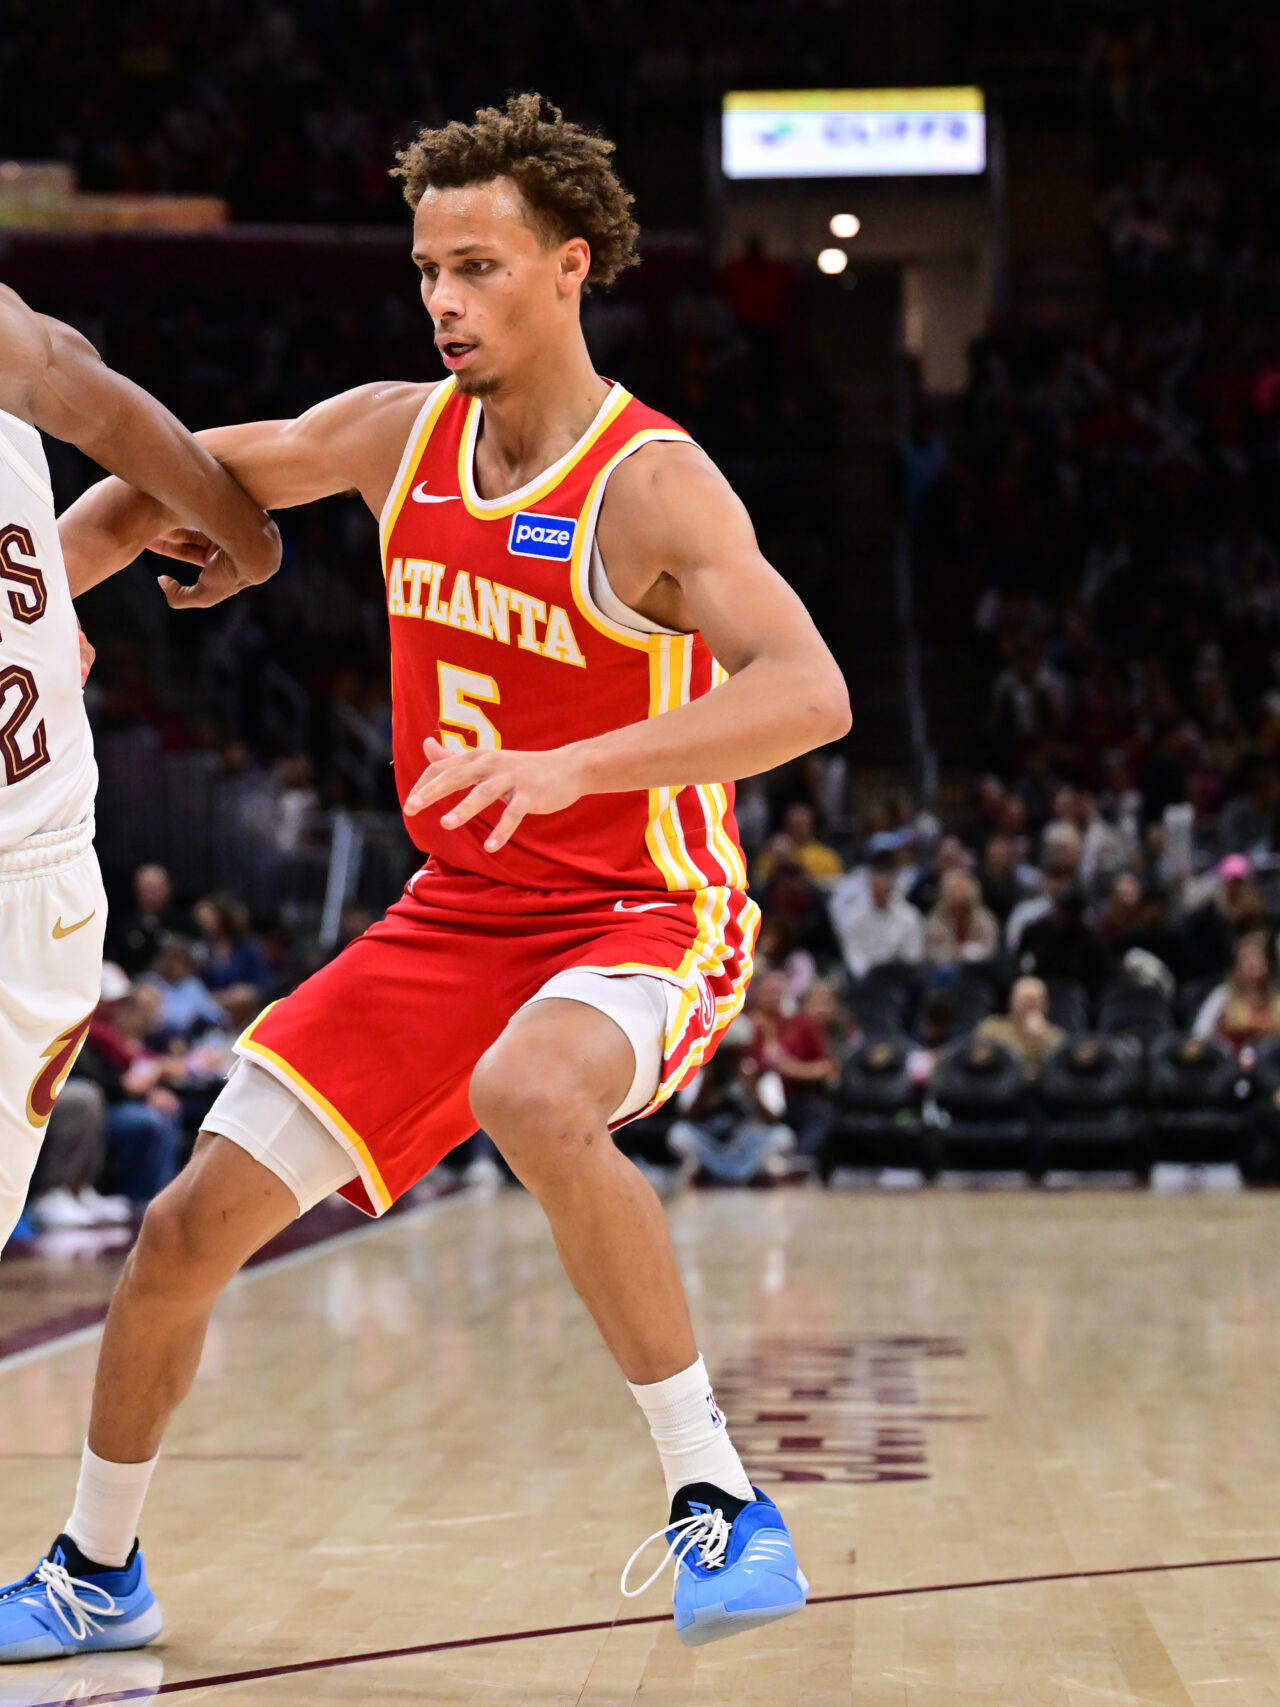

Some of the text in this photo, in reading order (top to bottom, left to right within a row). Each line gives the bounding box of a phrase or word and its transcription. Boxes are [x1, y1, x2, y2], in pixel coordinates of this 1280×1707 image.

[515, 525, 570, 546] paze
[389, 557, 587, 669] ATLANTA
[437, 660, 502, 751] 5
